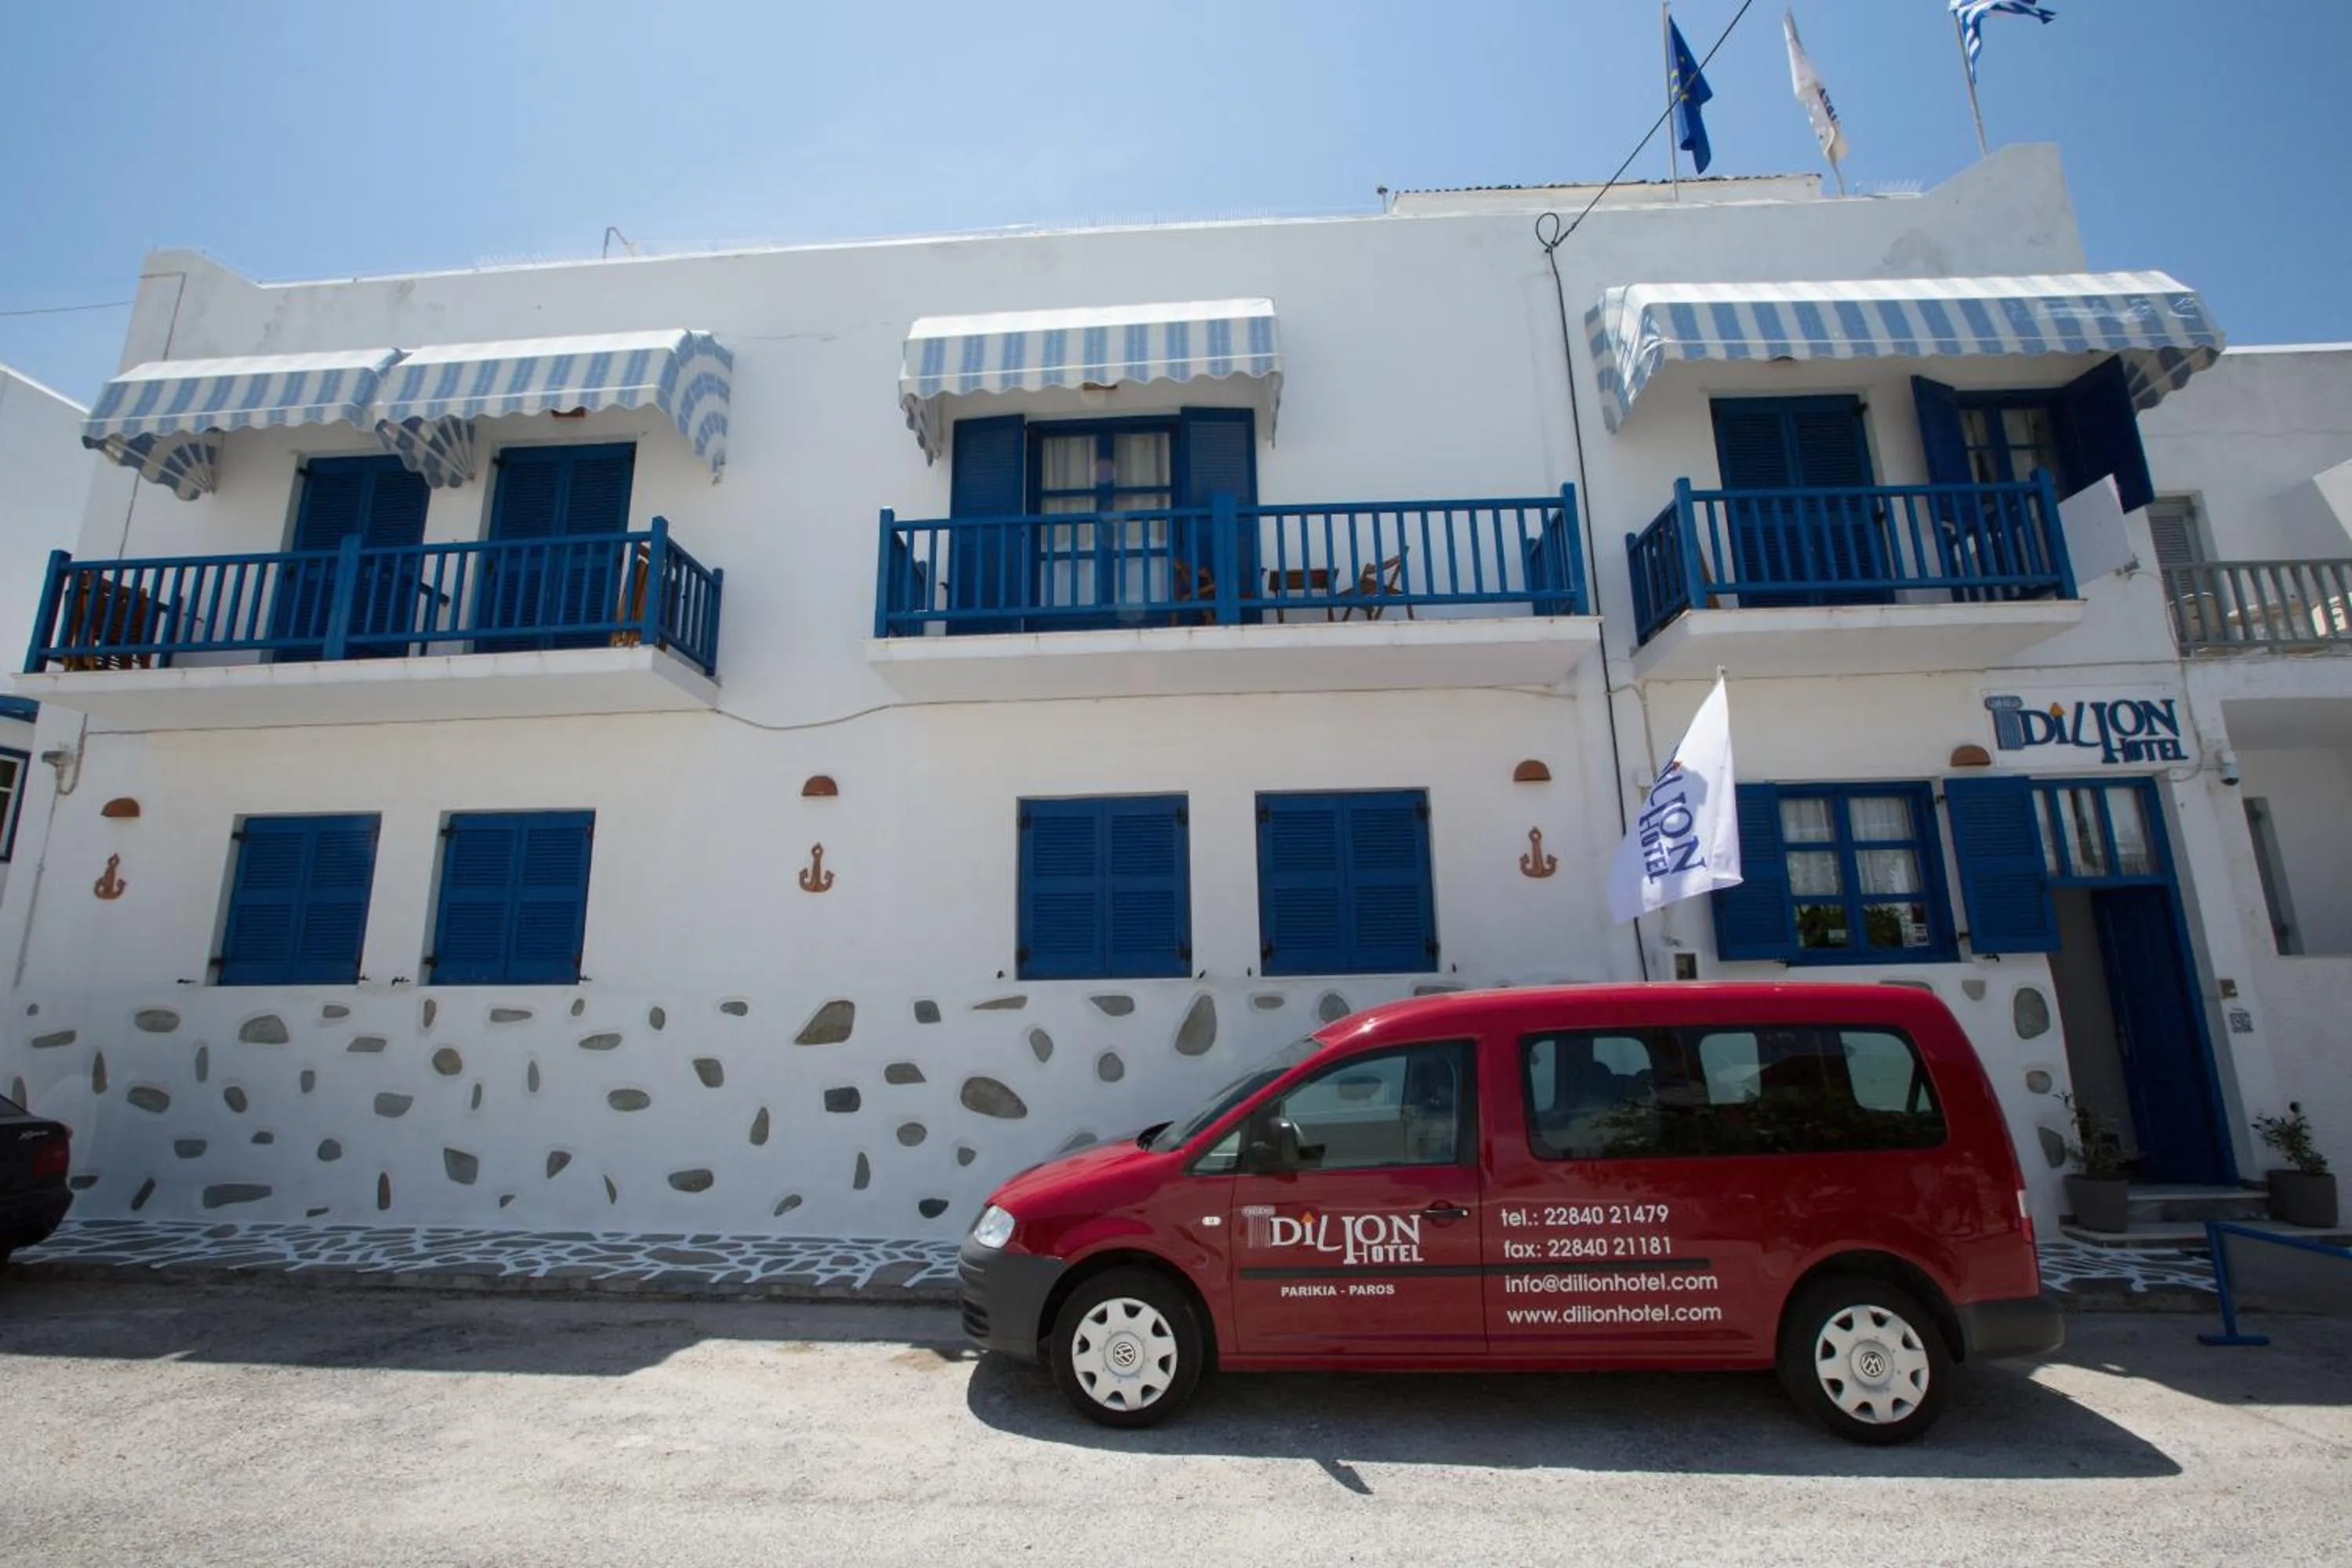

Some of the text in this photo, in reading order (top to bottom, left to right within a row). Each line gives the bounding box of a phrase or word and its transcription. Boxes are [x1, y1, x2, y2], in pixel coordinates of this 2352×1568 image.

[2114, 738, 2189, 763] HOTEL
[1639, 818, 1669, 884] HOTEL
[1501, 1204, 1669, 1227] tel.: 22840 21479
[1352, 1244, 1424, 1264] HOTEL
[1504, 1236, 1671, 1258] fax: 22840 21181
[1280, 1286, 1337, 1298] PARIKIA
[1349, 1284, 1395, 1295] PAROS
[1505, 1273, 1719, 1293] info@dilionhotel.com
[1507, 1305, 1722, 1323] www.dilionhotel.com
